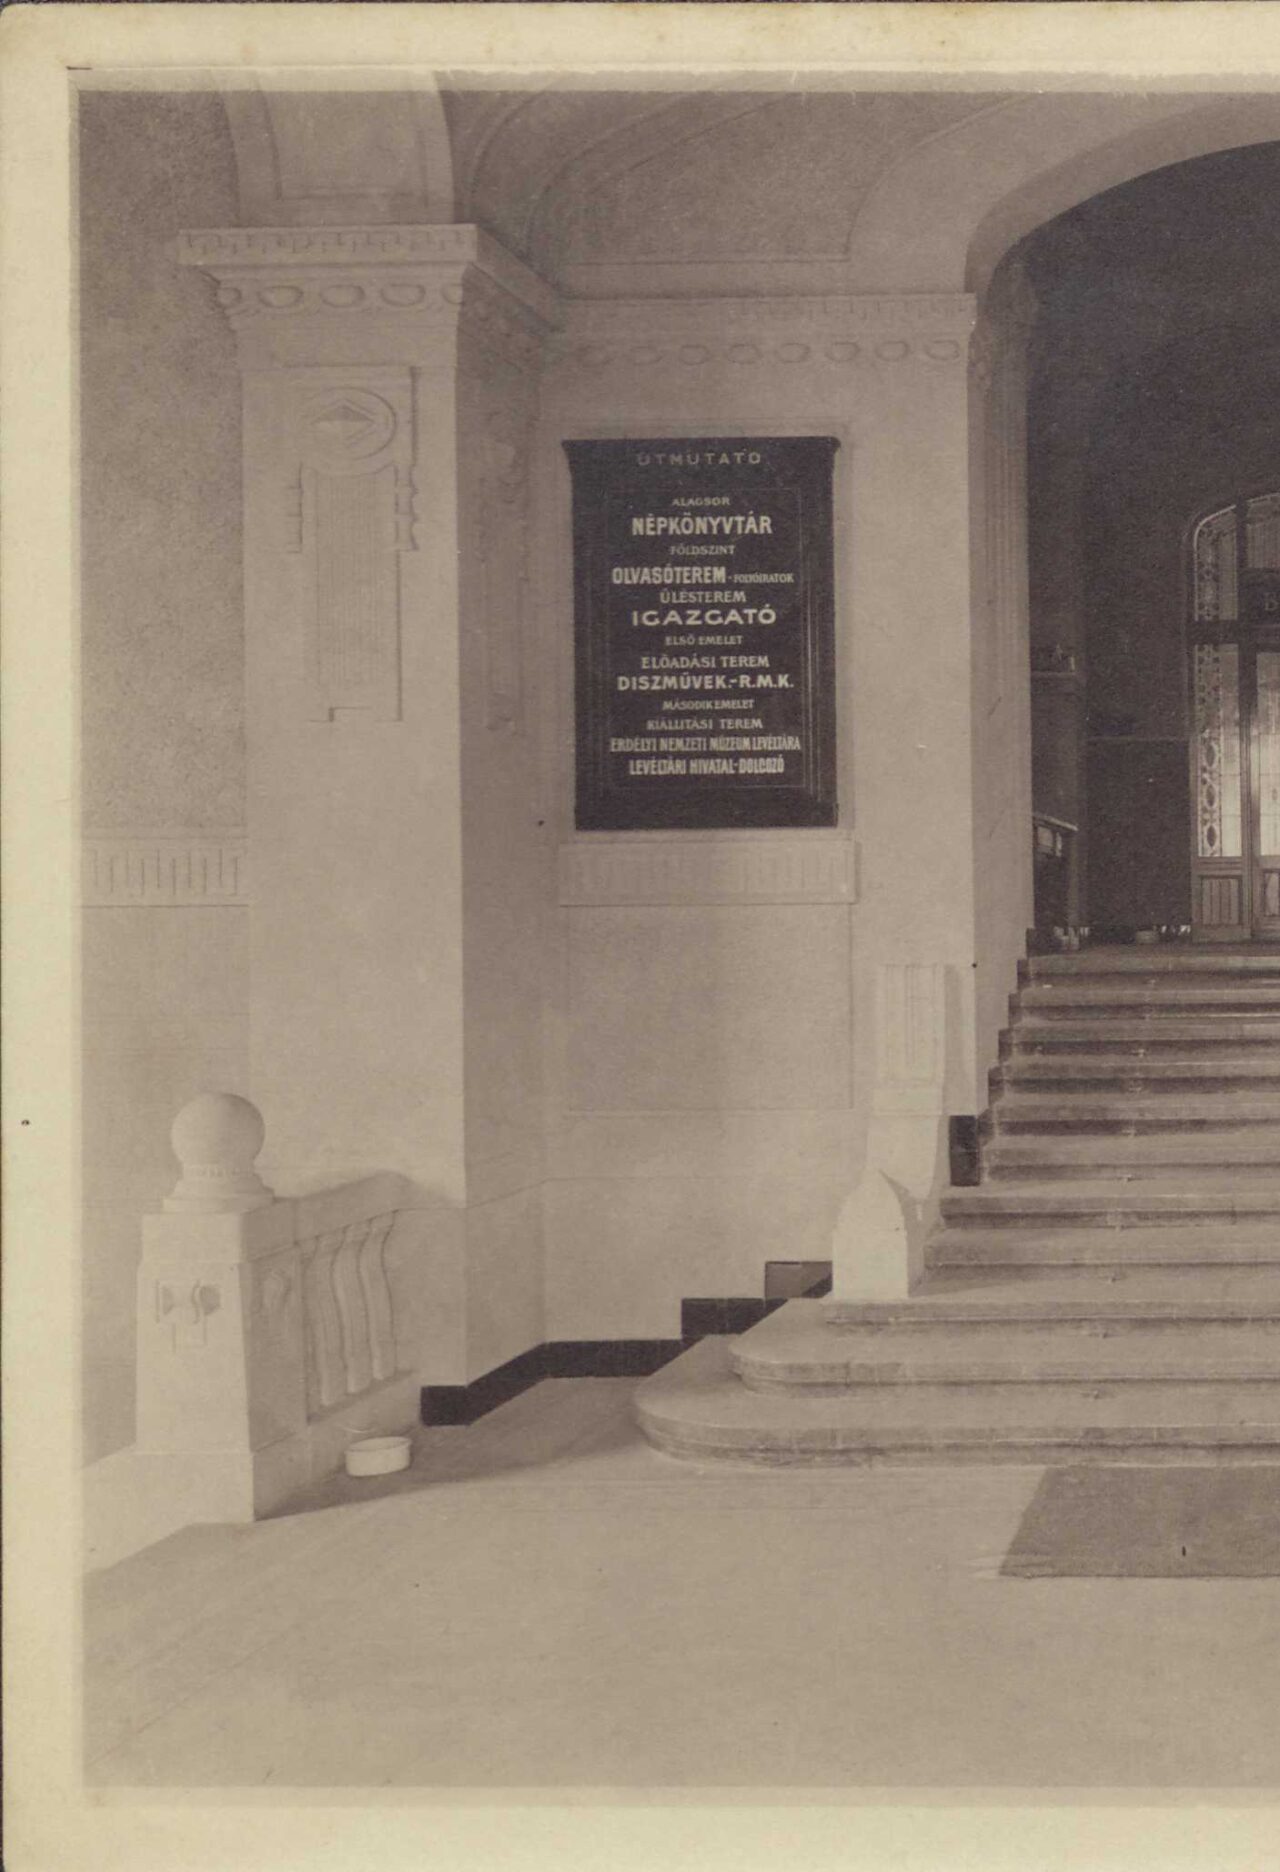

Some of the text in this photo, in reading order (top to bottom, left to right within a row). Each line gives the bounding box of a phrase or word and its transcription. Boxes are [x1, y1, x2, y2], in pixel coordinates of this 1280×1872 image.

[672, 497, 730, 506] ALAGSOR
[632, 511, 773, 535] NÉPKÖNYVTÁR
[612, 563, 726, 584] OLVASÓTEREM
[633, 604, 776, 626] IGAZGATÓ
[699, 636, 743, 645] EMELET
[721, 656, 769, 667] TEREM
[715, 700, 755, 709] EMELET
[719, 718, 763, 729] TEREM
